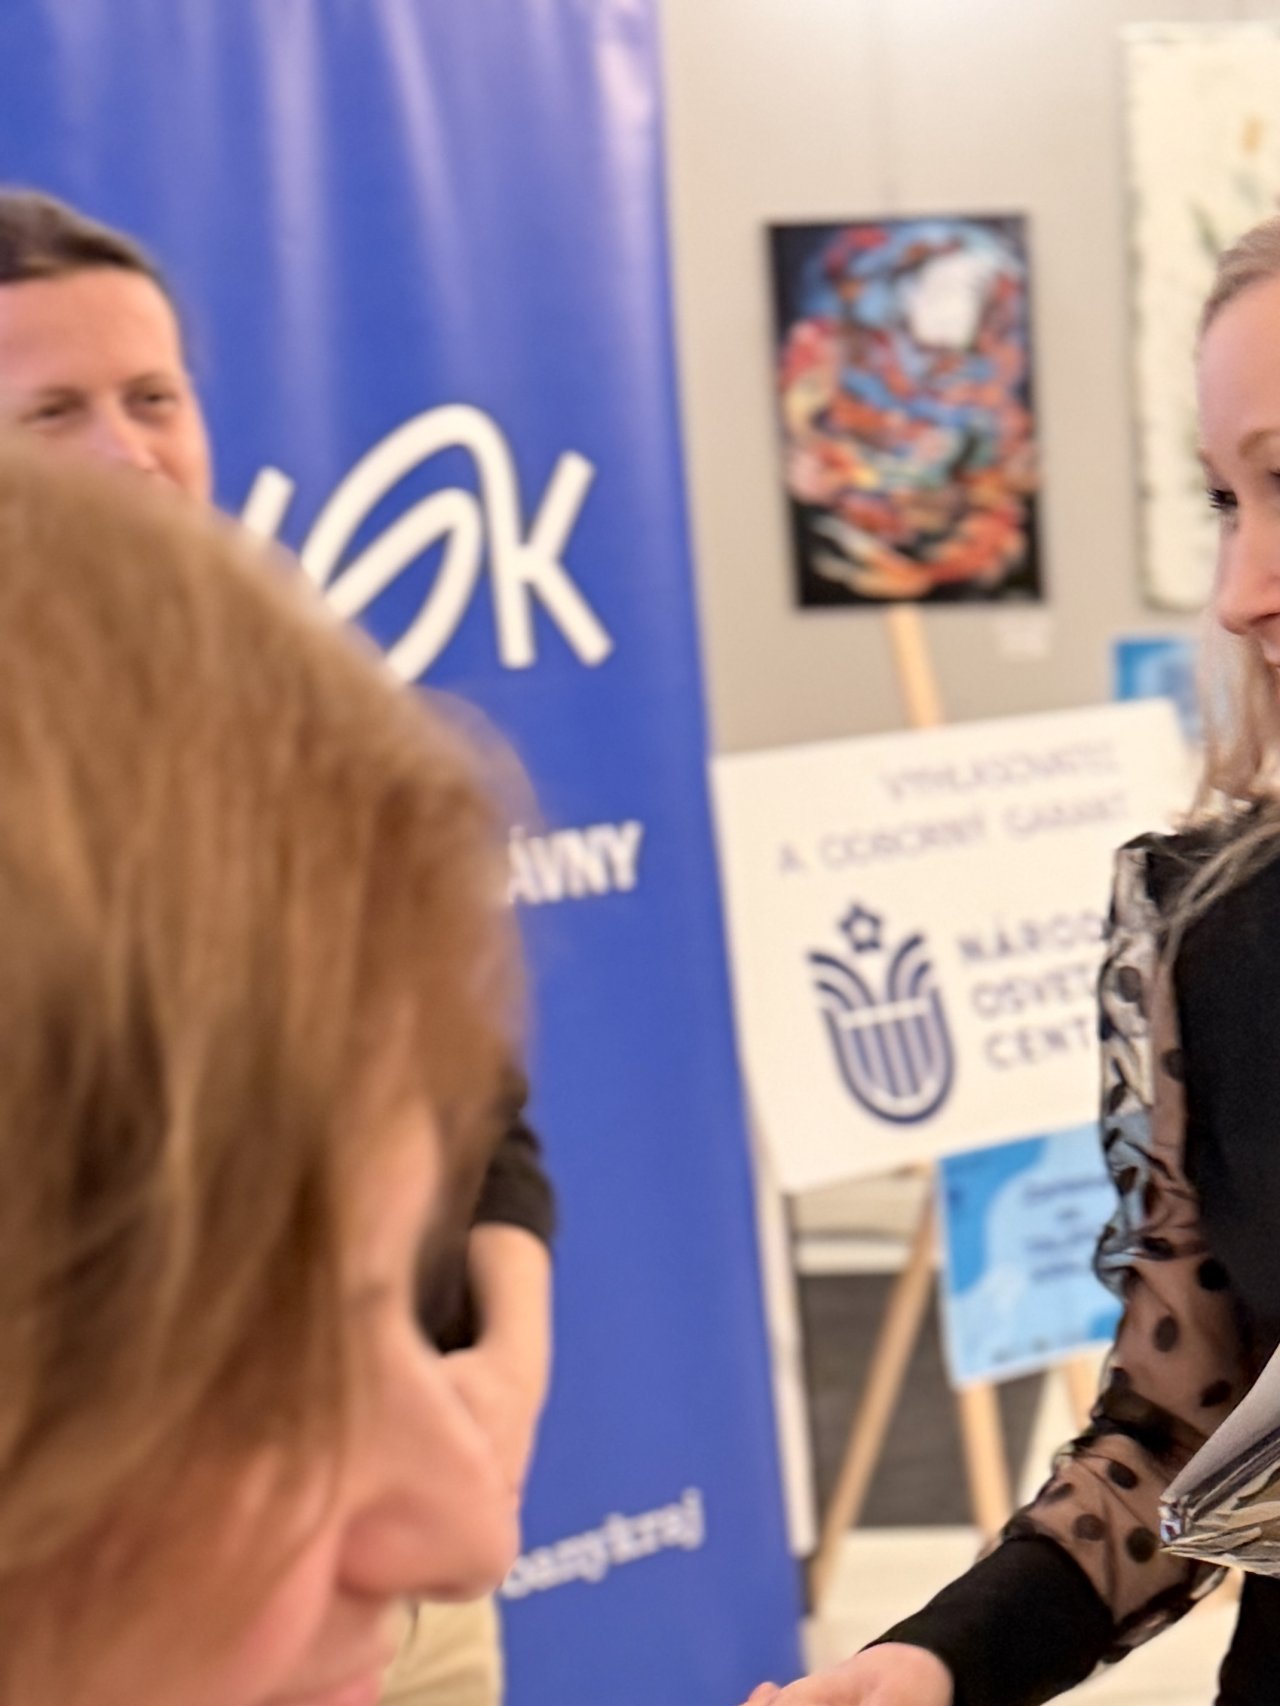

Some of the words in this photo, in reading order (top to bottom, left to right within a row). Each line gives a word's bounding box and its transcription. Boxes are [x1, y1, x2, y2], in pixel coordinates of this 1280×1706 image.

[507, 819, 643, 905] ÁVNY
[957, 910, 1106, 960] NÁROD
[984, 1015, 1092, 1071] CENT
